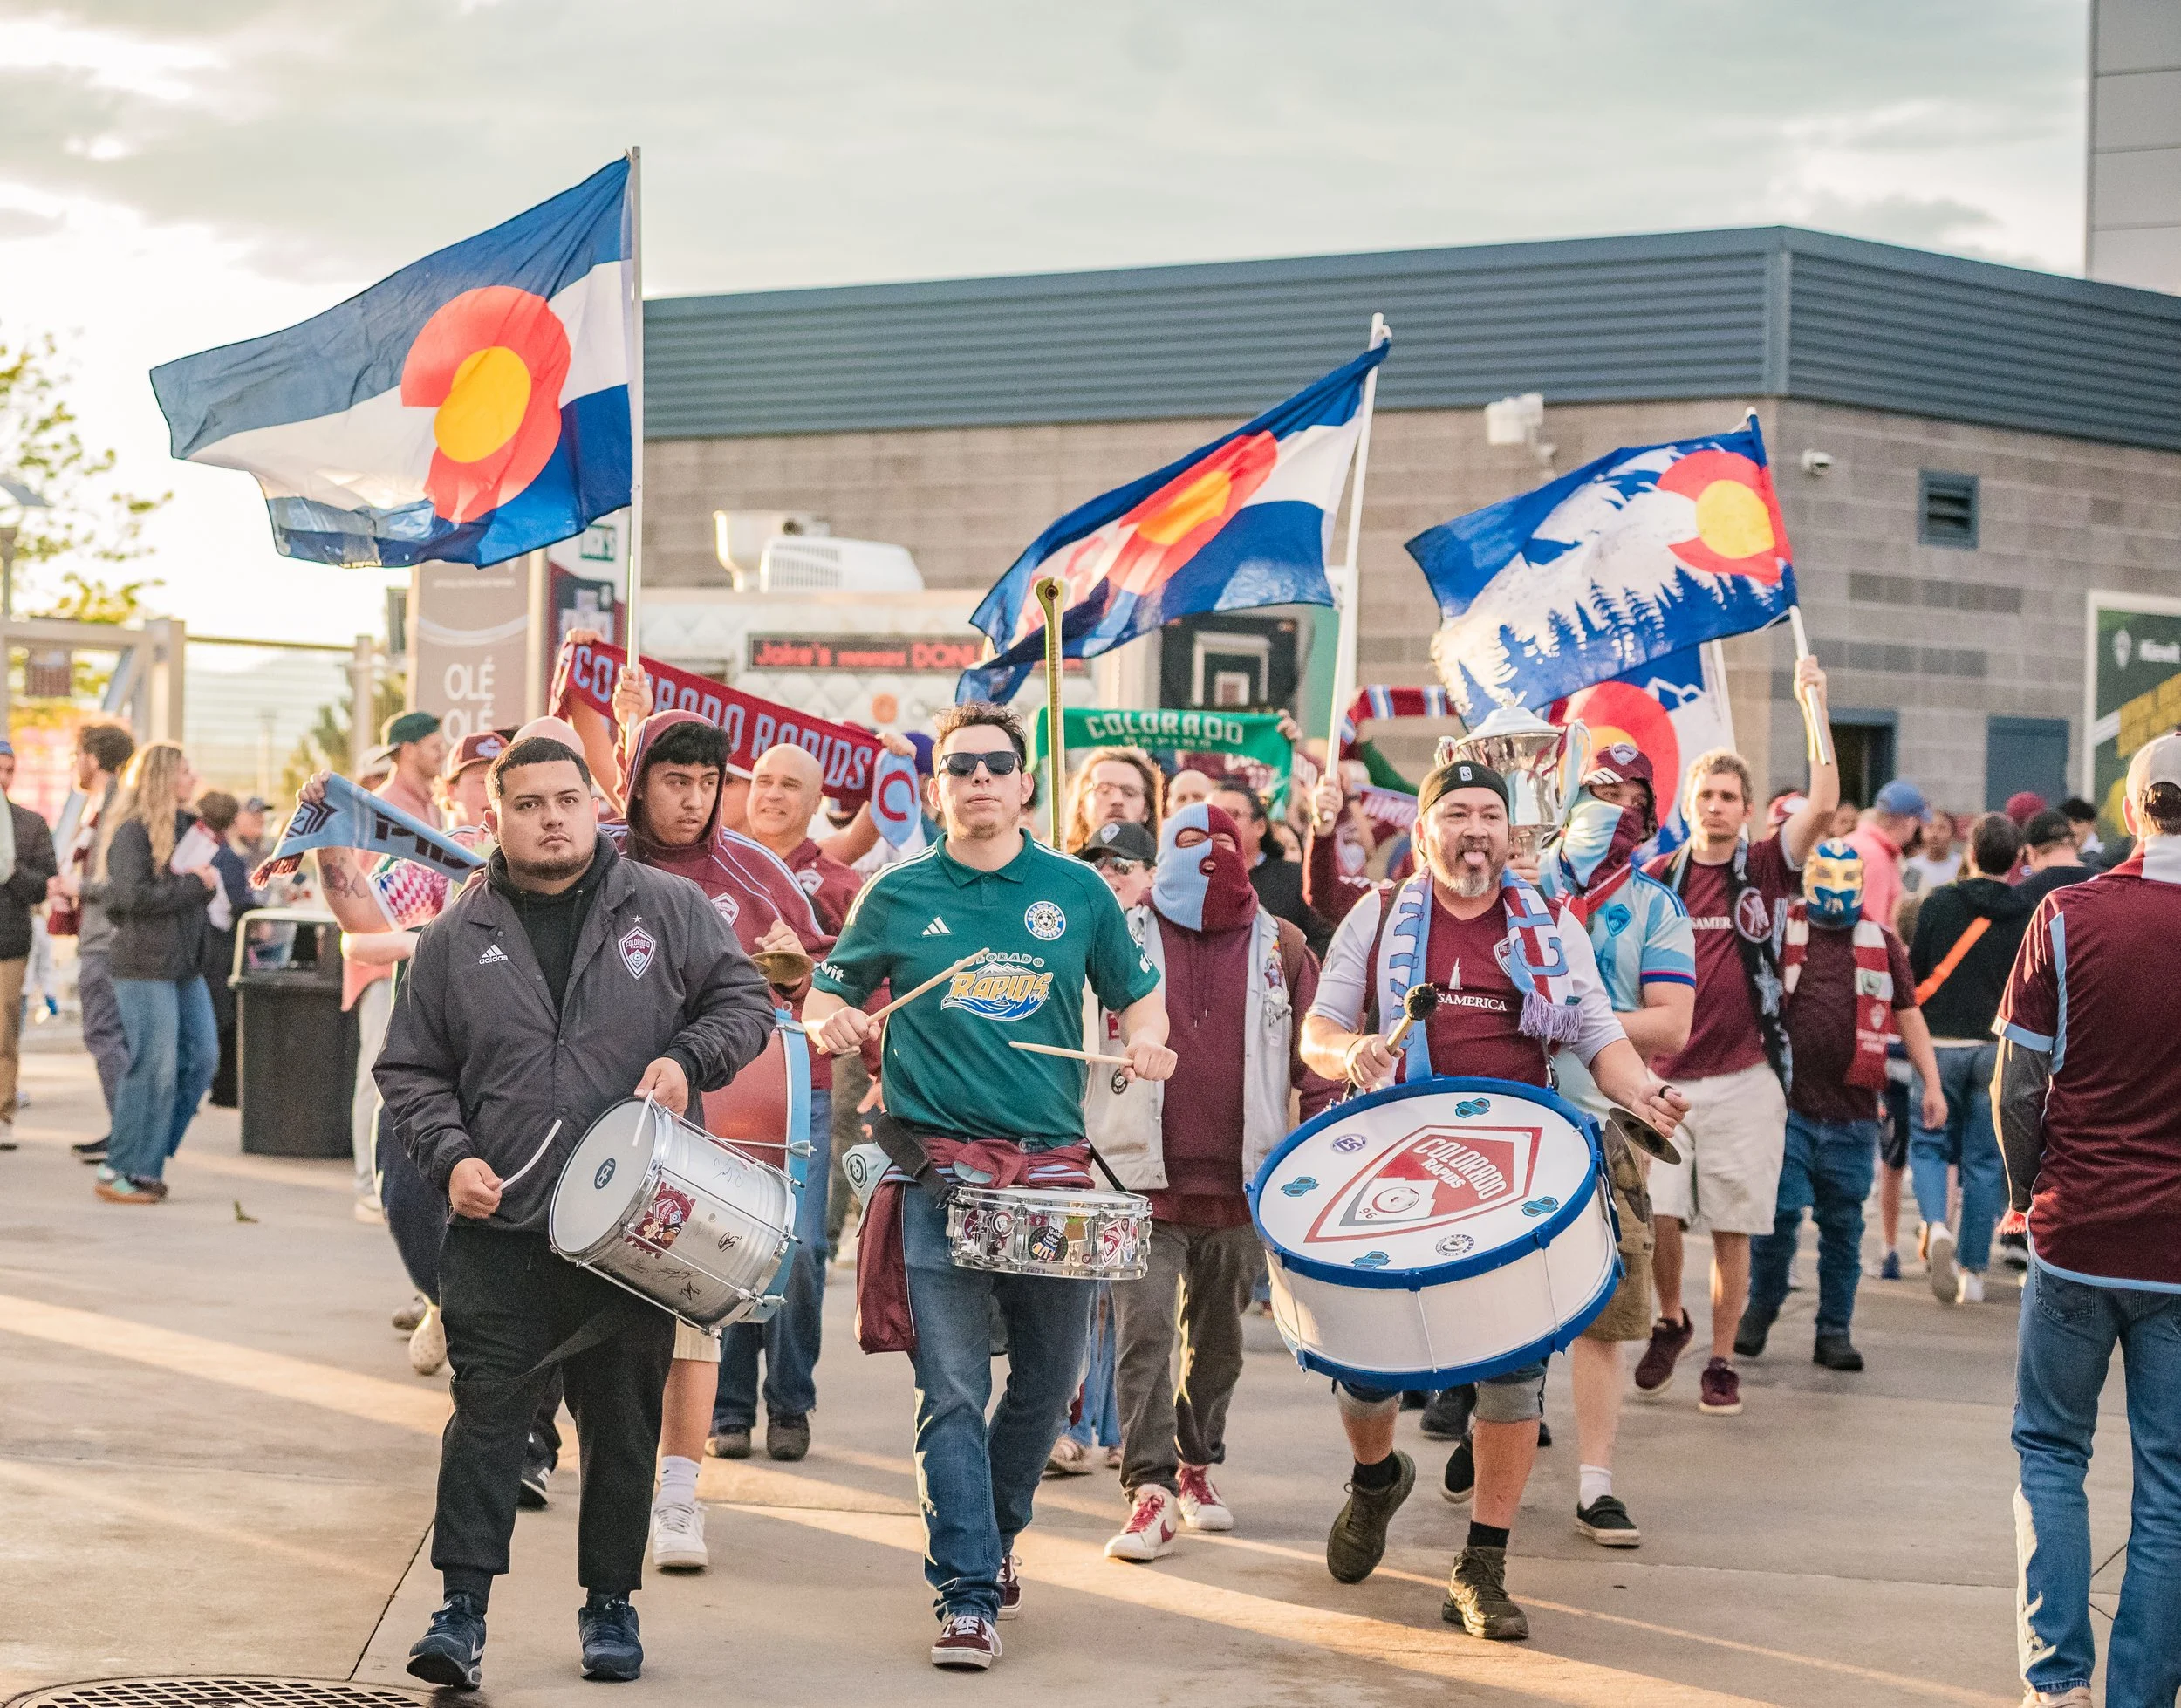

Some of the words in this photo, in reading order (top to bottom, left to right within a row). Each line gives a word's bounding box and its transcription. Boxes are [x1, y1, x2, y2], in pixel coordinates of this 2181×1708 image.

[444, 655, 496, 701] OLÉ
[574, 646, 745, 752] CORADO
[1085, 712, 1244, 745] COLORADO
[626, 939, 651, 948] COLORADO
[479, 954, 509, 965] adidas
[951, 972, 1053, 1003] RAPIDS
[1437, 993, 1508, 1011] SAMERICA
[1412, 1138, 1508, 1200] COLORADO
[1420, 1158, 1467, 1189] RAPIDS
